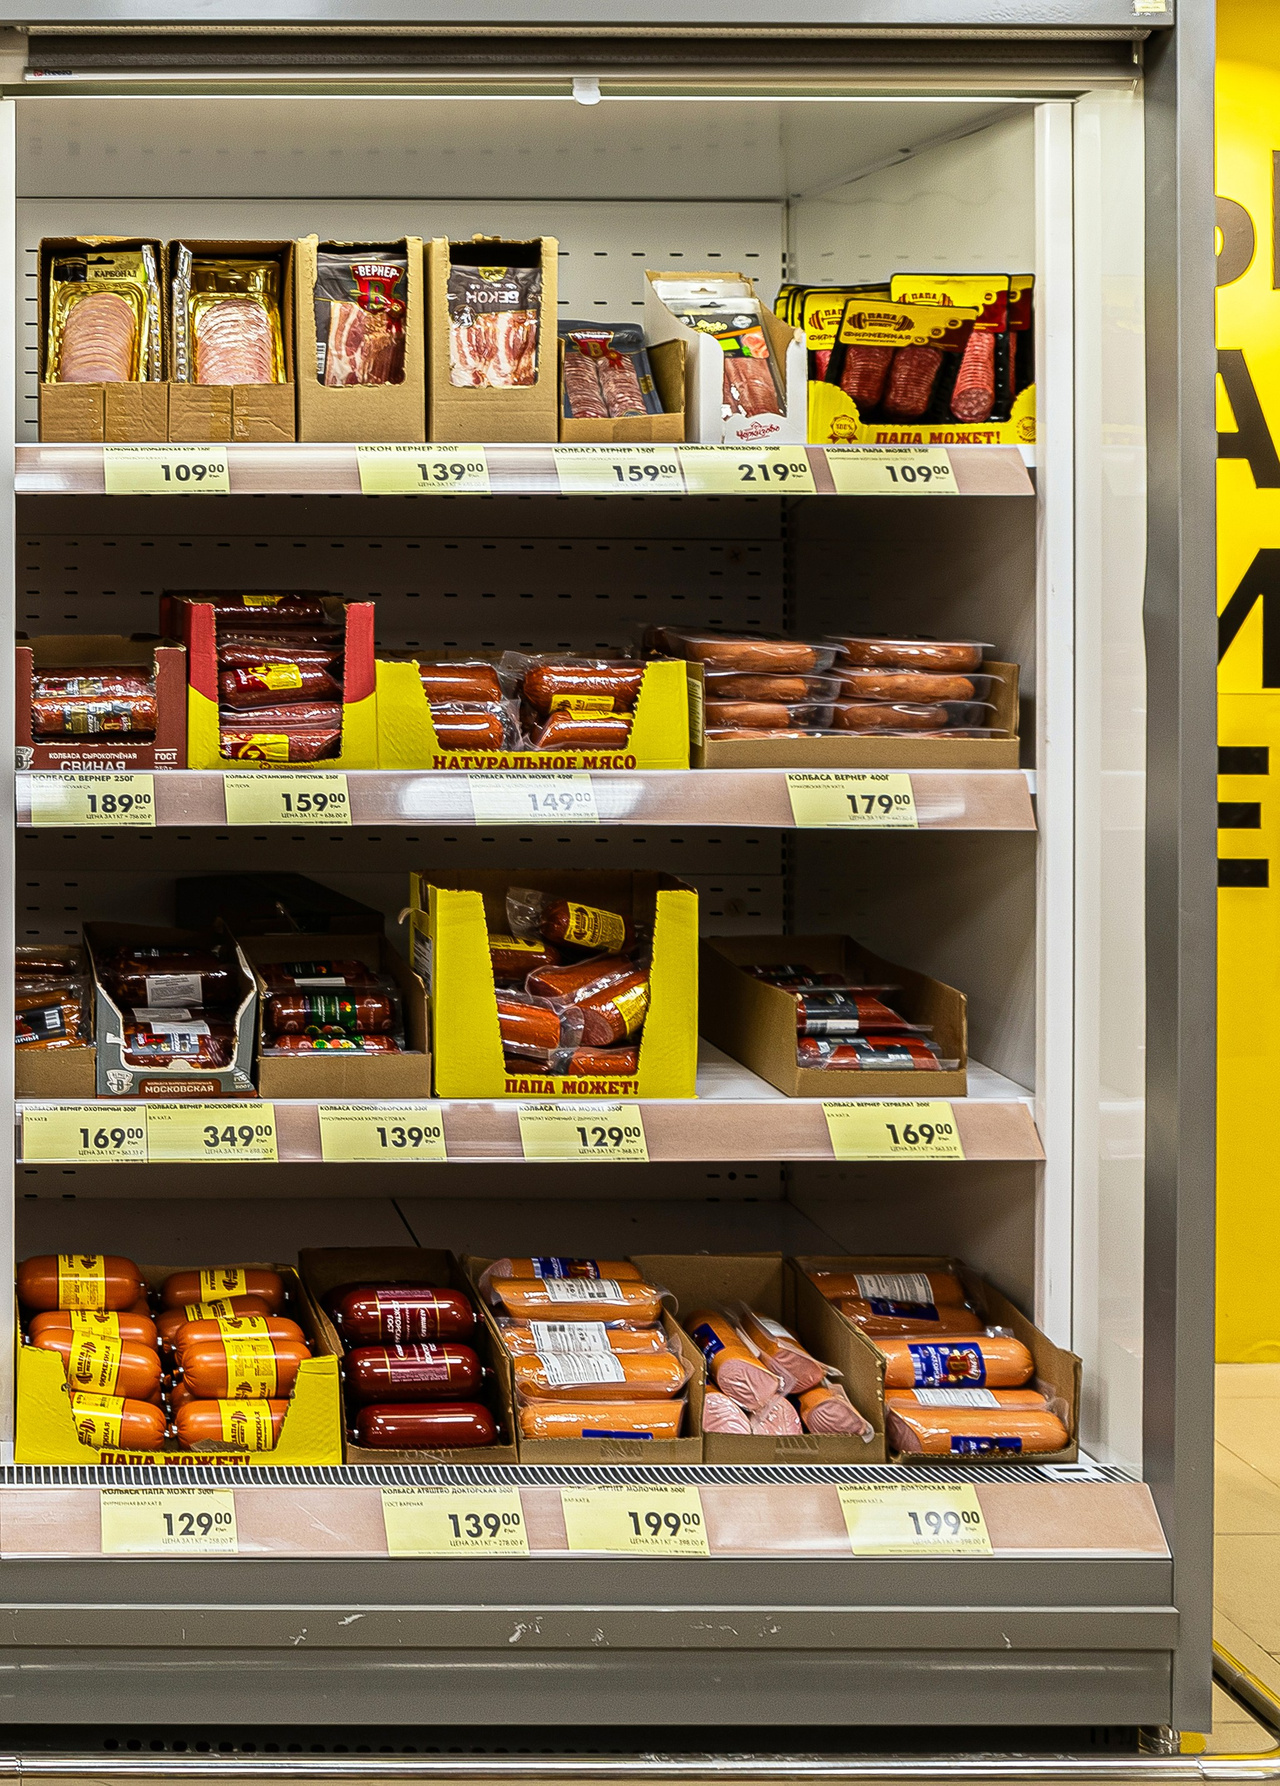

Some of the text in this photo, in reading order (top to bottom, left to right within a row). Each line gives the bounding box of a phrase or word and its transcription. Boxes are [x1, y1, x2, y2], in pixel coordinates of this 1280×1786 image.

[94, 270, 137, 278] КАРБОНАД
[358, 265, 396, 278] ВЕРНЕР
[465, 290, 520, 303] БЕКОН
[911, 292, 937, 300] ПАПА
[868, 312, 897, 321] ПАПА
[843, 331, 911, 340] ФИРМЕННАЯ
[876, 431, 1001, 444] ПАПА МОЖЕТ!
[154, 753, 178, 761] ГОСТ
[432, 755, 637, 770] НАТУРАЛЬНОЕ МЯСО
[60, 761, 126, 770] СВИНАЯ
[33, 774, 134, 782] КОЛБАСА ВЕРНЕР 250Г
[145, 1084, 214, 1094] МОСКОВСКАЯ
[504, 1079, 640, 1095] ПАПА МОЖЕТ!
[386, 1314, 394, 1333] ГОСТ
[76, 1351, 85, 1372] ПАПА
[100, 1452, 251, 1466] ПАПА МОЖЕТ!
